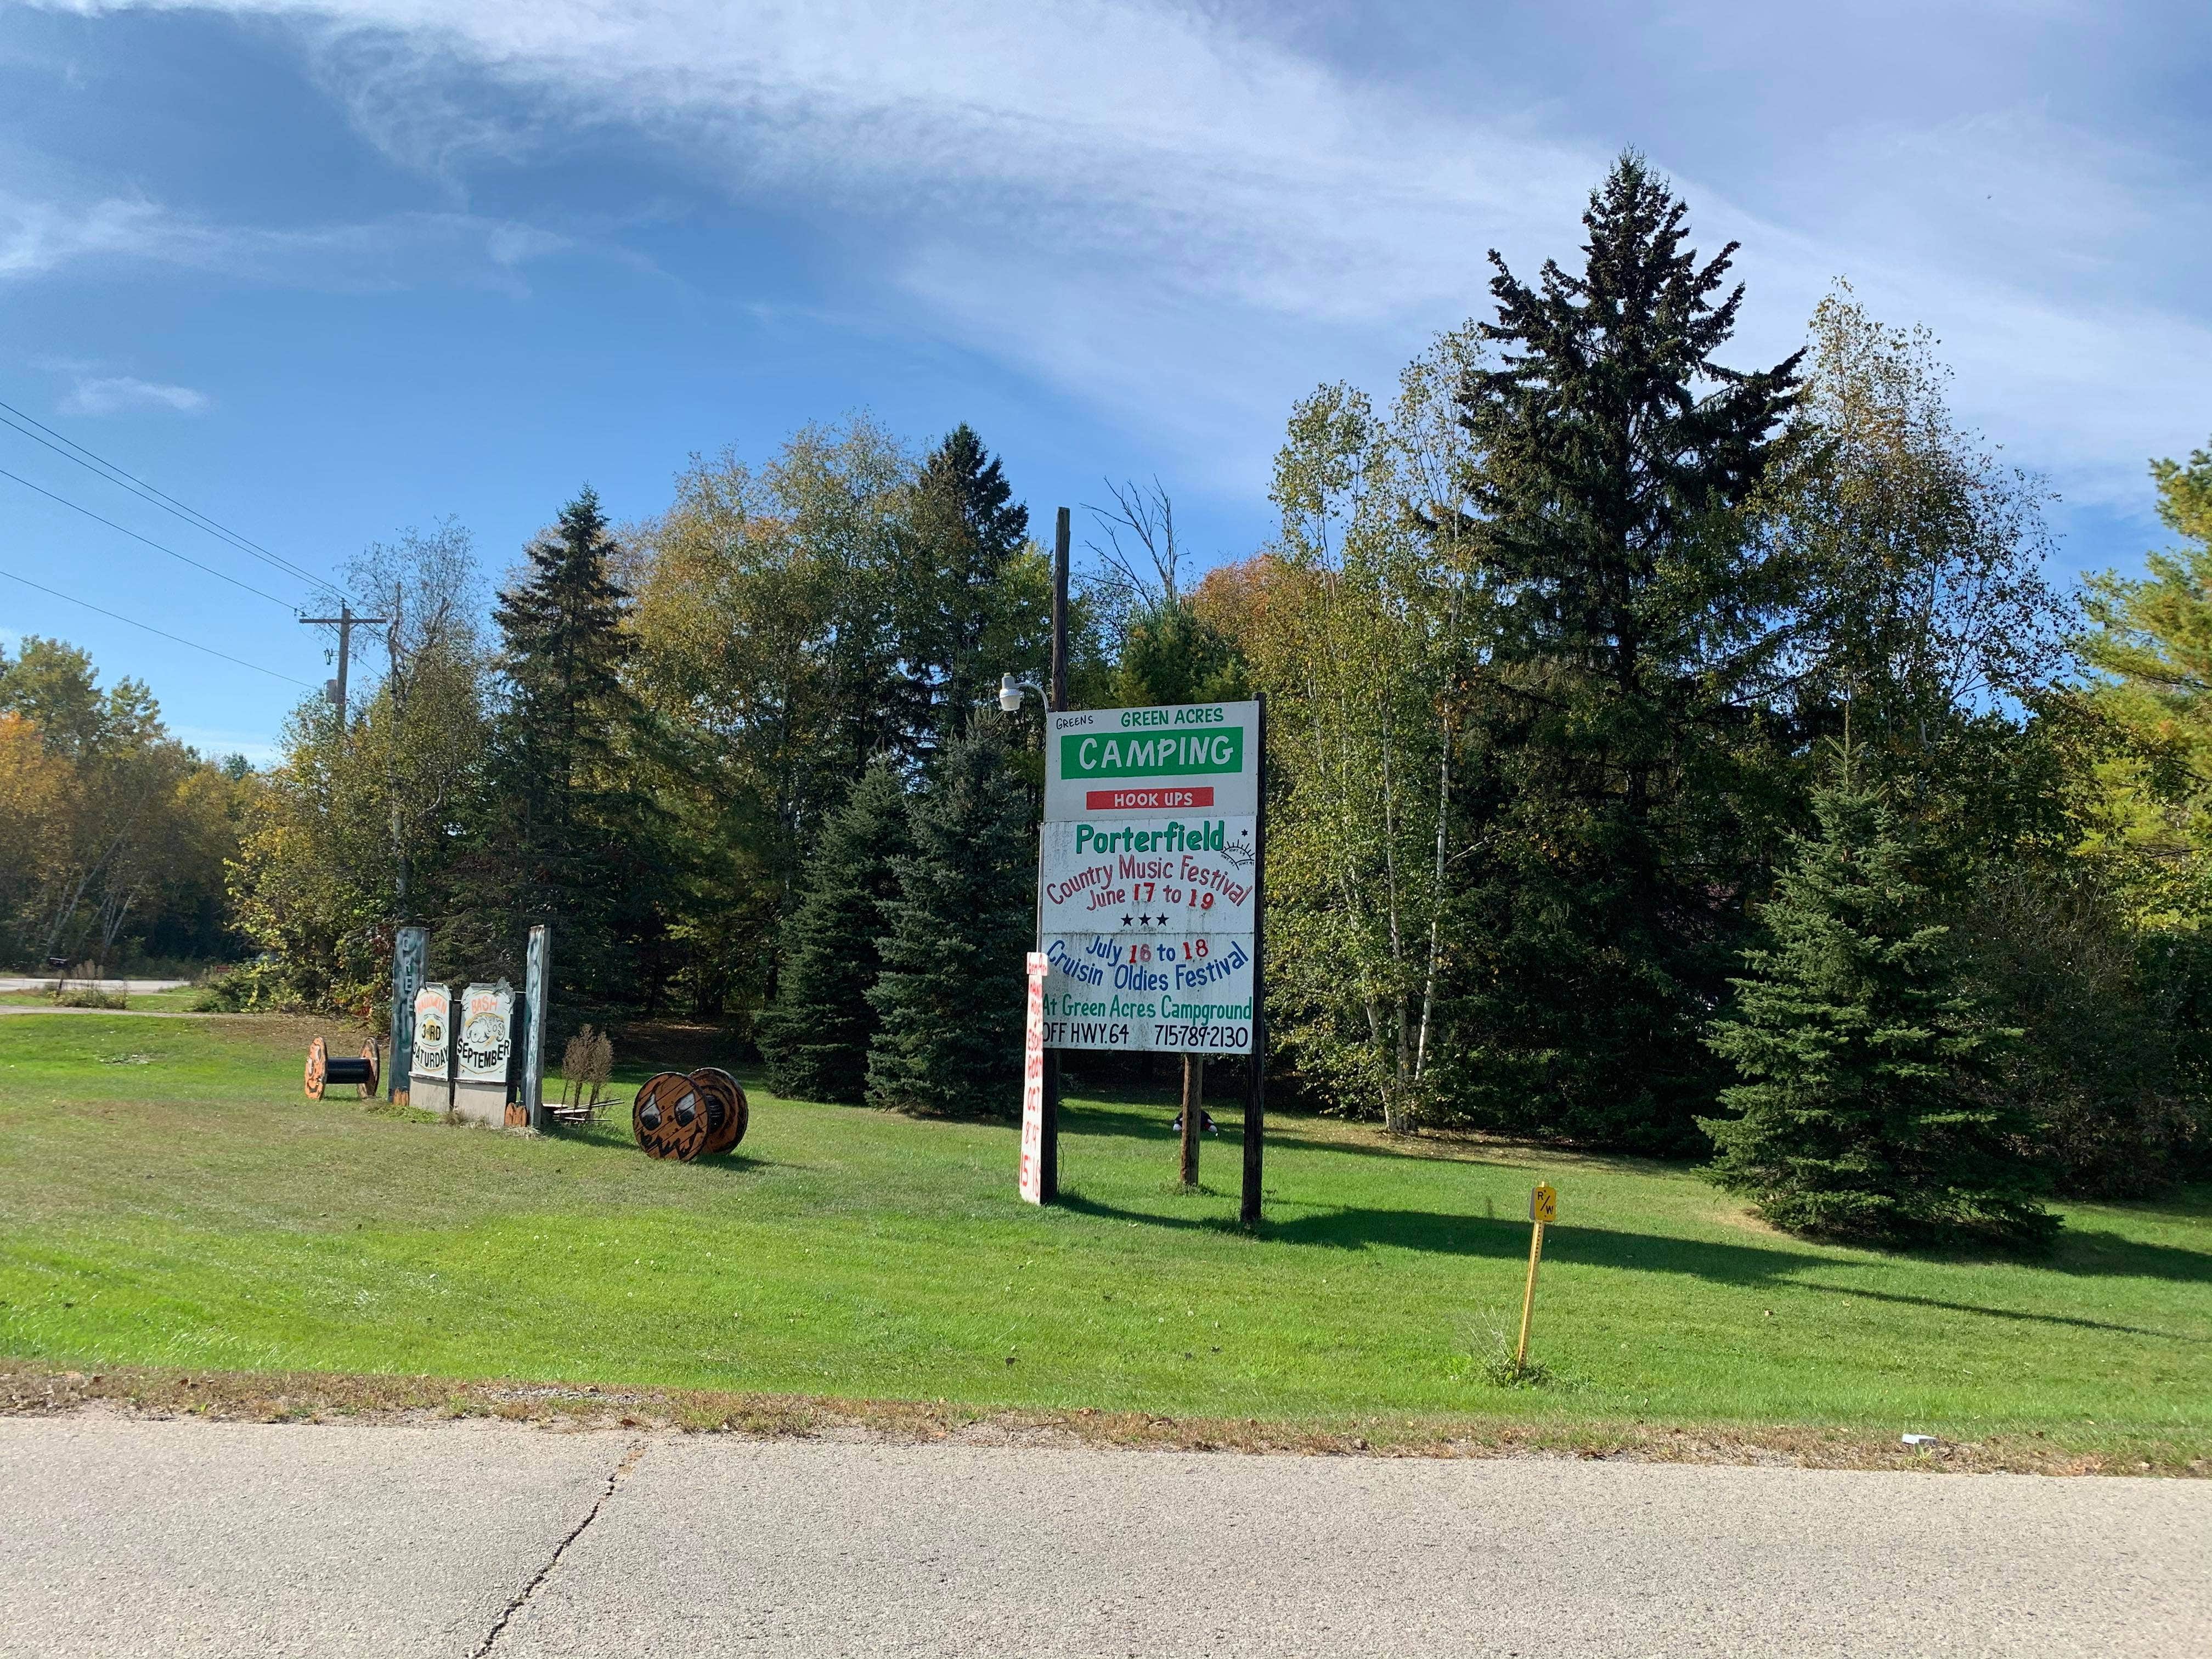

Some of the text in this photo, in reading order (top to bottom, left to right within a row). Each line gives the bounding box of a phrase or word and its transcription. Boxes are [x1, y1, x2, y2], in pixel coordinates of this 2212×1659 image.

[1121, 707, 1224, 727] GREEN ACRES
[1079, 735, 1234, 770] CAMPING
[1114, 793, 1193, 807] HOOK UPS
[1076, 820, 1225, 854] Porterfield
[1047, 854, 1252, 907] Country Music Festival
[1087, 882, 1215, 911] June 17 to 19
[1047, 940, 1249, 991] Cruisin Oldies Festival
[1086, 935, 1122, 967] July
[1157, 944, 1176, 961] to
[1183, 939, 1209, 960] 18
[472, 995, 498, 1015] BASH
[1062, 994, 1106, 1017] Green
[1109, 995, 1156, 1019] Acres
[1161, 995, 1252, 1026] Campground
[1154, 1024, 1248, 1047] 715-789-2130
[413, 1042, 449, 1068] SATURDAY
[457, 1040, 510, 1068] SEPTEMBER
